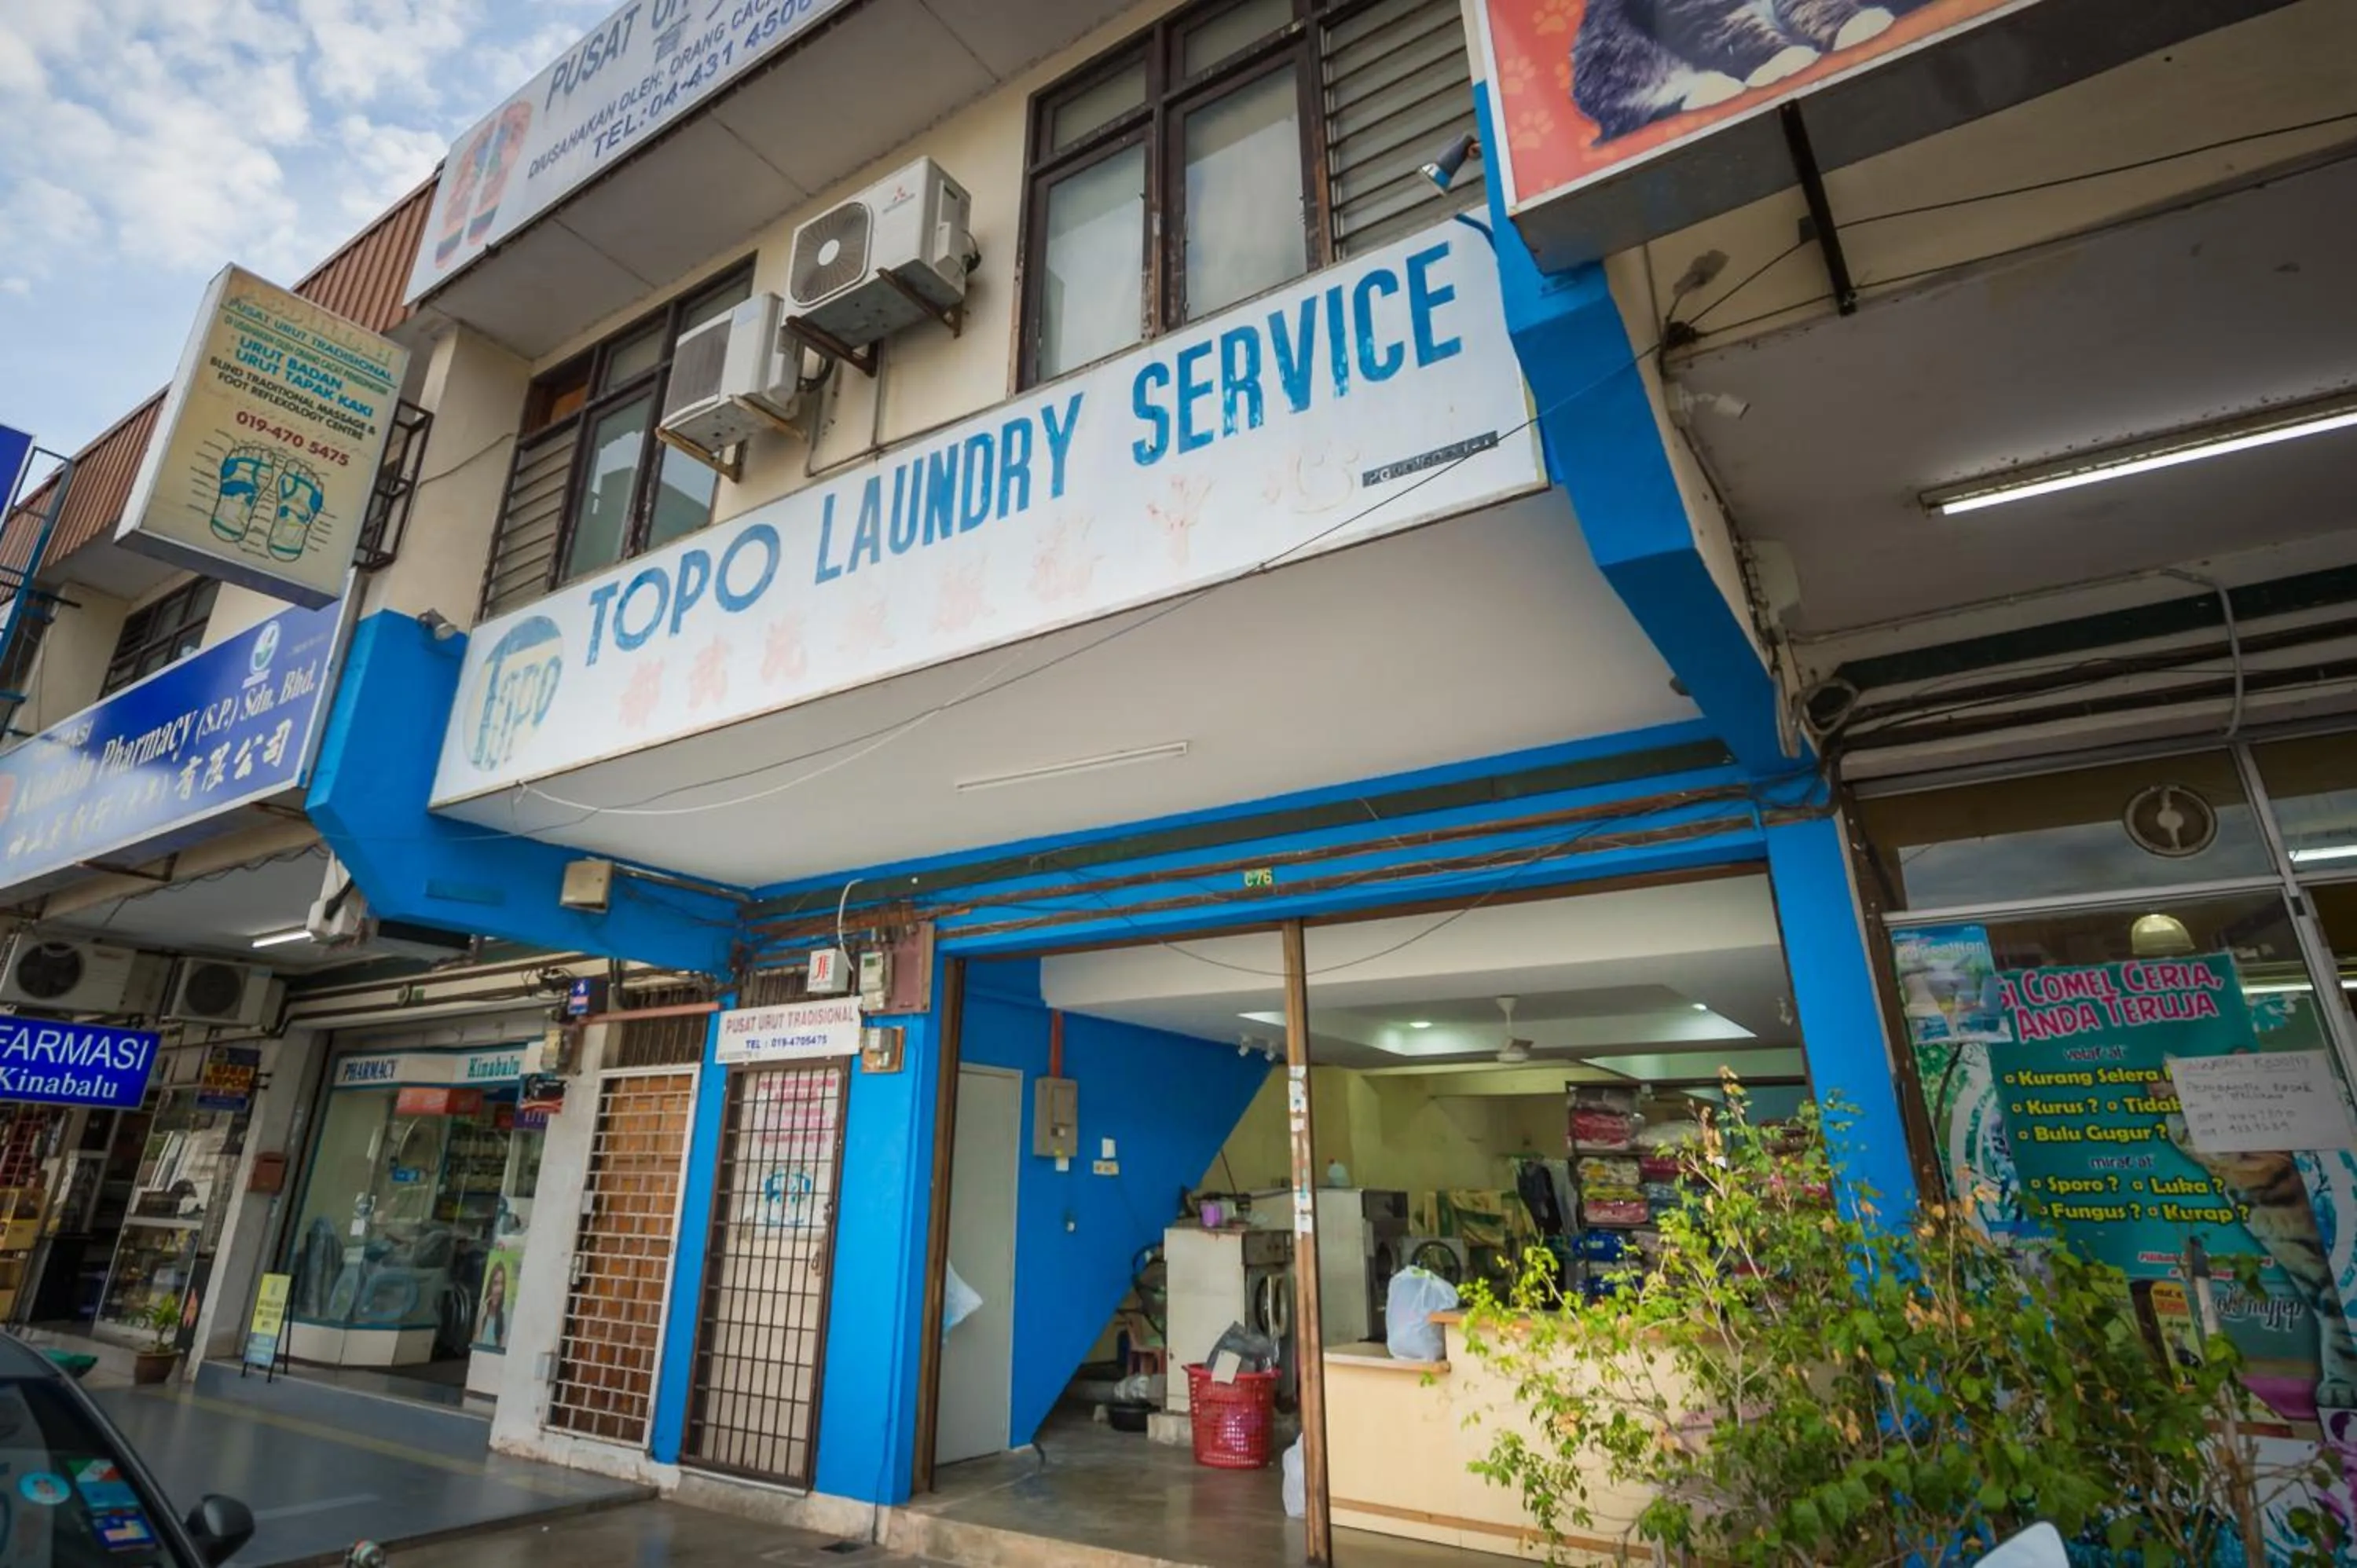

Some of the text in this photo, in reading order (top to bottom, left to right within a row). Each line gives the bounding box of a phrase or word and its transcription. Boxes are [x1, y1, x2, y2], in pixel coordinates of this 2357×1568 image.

[545, 3, 642, 112] PUSAT
[669, 22, 725, 75] ORANG
[731, 0, 770, 29] CAC
[229, 298, 392, 382] PUSAT URUT TRADISIONAL
[239, 335, 284, 363] URUT
[286, 356, 343, 390] BADAN
[210, 356, 244, 378] BLIND
[246, 371, 315, 408] TRADITIONAL
[317, 402, 367, 431] MASSAGE
[217, 372, 365, 441] FOOT REFLEXOLOGY CENTRE
[235, 348, 280, 376] URUT
[284, 368, 333, 401] TAPAK
[337, 394, 374, 418] KAKI
[236, 410, 351, 467] 019-470 5475
[585, 523, 781, 668] TOPO
[815, 392, 1084, 586] LAUNDRY
[1131, 240, 1462, 467] SERVICE
[96, 709, 198, 782] Pharmacy
[196, 695, 240, 745] (S.P.)
[240, 682, 275, 722] Sdn.
[278, 658, 316, 705] Bhd.
[2022, 967, 2120, 1006] COMEL
[2121, 960, 2225, 993] CERIA,
[726, 1005, 855, 1035] PUSAT URUT TRADISIONAL
[2014, 991, 2220, 1044] ANDA TERUJA
[0, 1066, 119, 1100] Kinabalu
[342, 1054, 522, 1082] PHARMACY Kinabalu
[2018, 1070, 2093, 1086] Kurang
[2097, 1067, 2159, 1084] Selera
[2025, 1099, 2084, 1115] Kurus
[2033, 1125, 2082, 1141] Bulu
[2085, 1124, 2152, 1143] Gugur
[2047, 1175, 2105, 1195] Sporo
[2150, 1177, 2209, 1195] Luka
[2051, 1202, 2127, 1222] Fungus
[2161, 1203, 2234, 1224] Kurap
